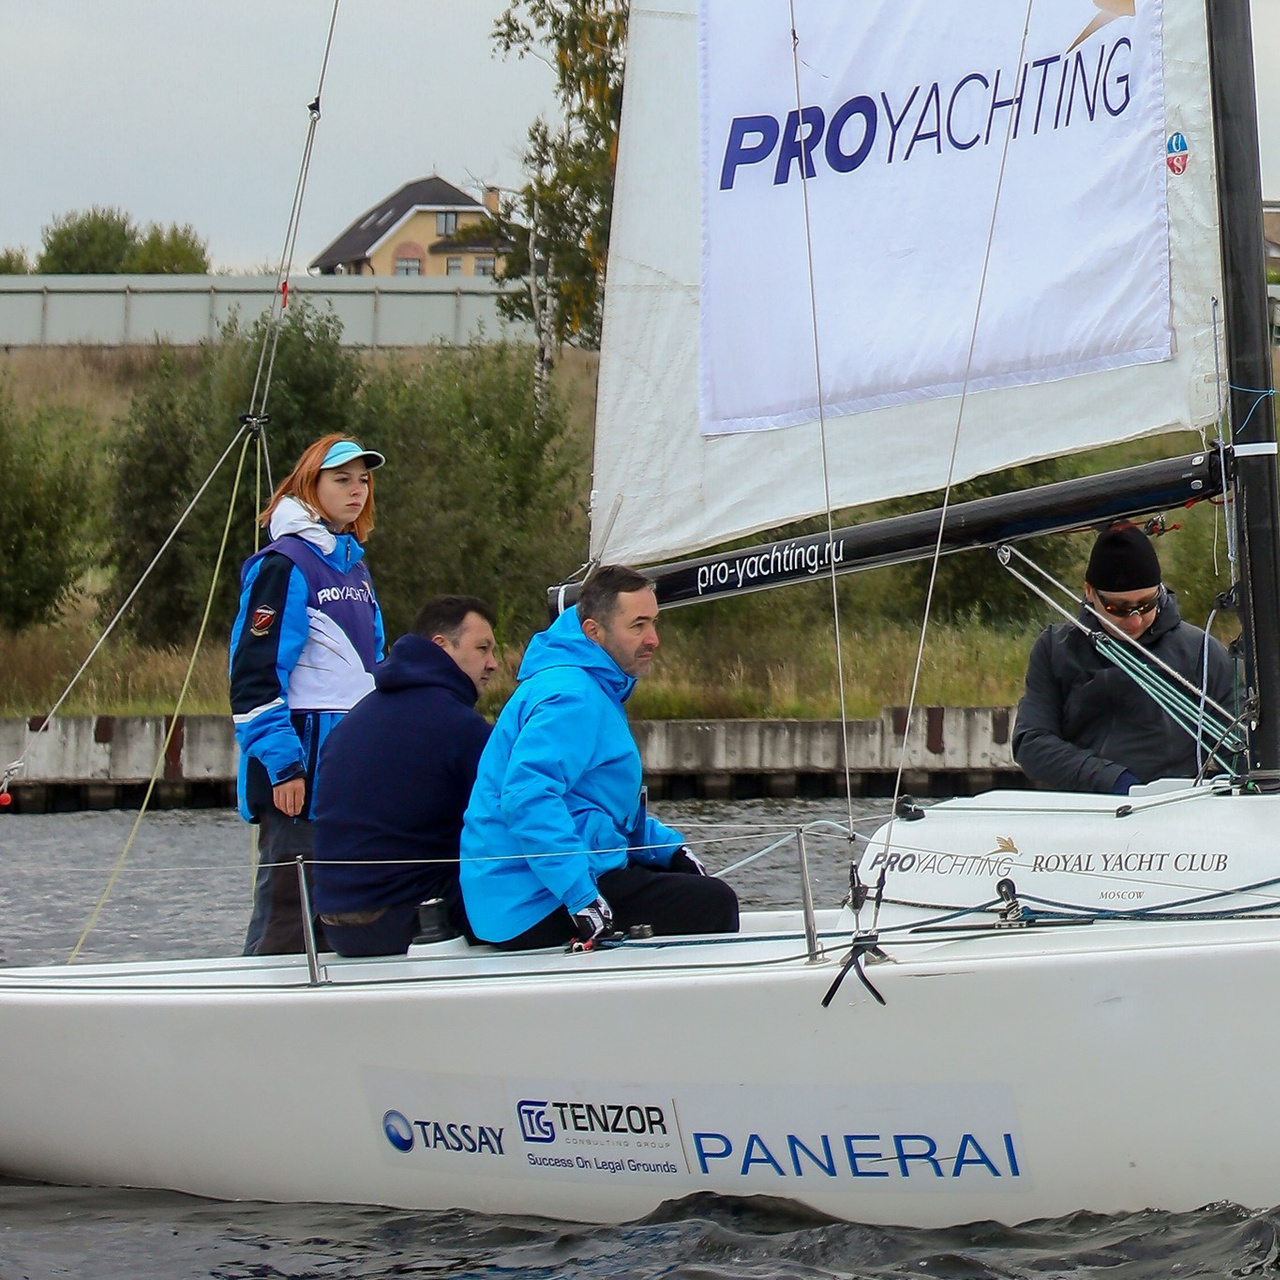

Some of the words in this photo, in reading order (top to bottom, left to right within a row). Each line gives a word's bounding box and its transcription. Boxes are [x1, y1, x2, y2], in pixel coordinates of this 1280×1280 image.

[718, 36, 1132, 191] PROYACHTING
[697, 539, 845, 595] pro-yachting.ru
[868, 852, 1015, 878] PROYACHTING
[1031, 854, 1096, 873] ROYAL
[1100, 852, 1170, 872] YACHT
[1172, 853, 1229, 872] CLUB
[1098, 890, 1145, 900] MOSCOW
[551, 1102, 668, 1135] TENZOR
[413, 1120, 505, 1155] TASSAY
[565, 1137, 629, 1148] CONSULTING
[636, 1141, 671, 1149] GROUP
[527, 1153, 574, 1168] Success
[576, 1156, 592, 1169] On
[595, 1157, 625, 1175] Legal
[627, 1158, 678, 1174] Grounds
[692, 1132, 1021, 1178] PANERAI
